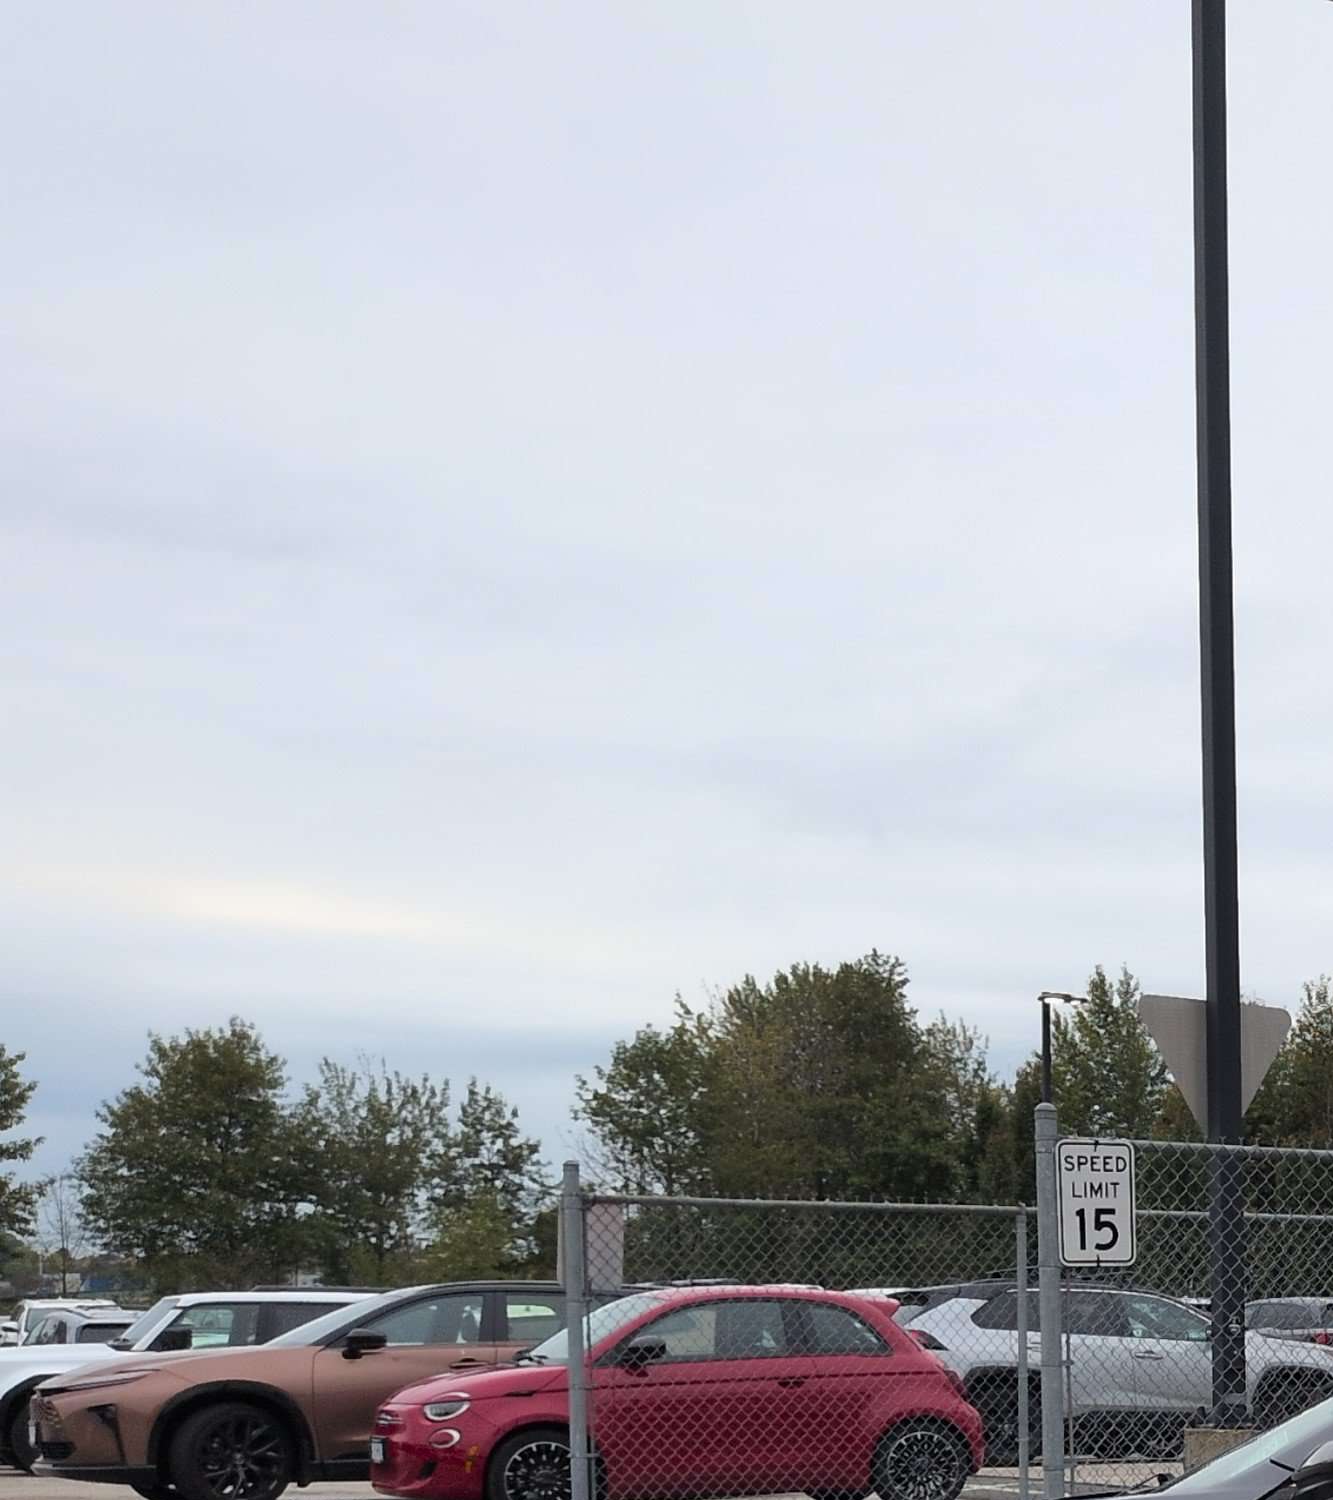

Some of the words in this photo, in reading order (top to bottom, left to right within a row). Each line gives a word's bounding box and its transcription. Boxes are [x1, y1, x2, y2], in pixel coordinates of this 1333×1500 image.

[1064, 1155, 1127, 1173] SPEED
[1072, 1181, 1120, 1199] LIMIT
[1075, 1208, 1119, 1251] 15
